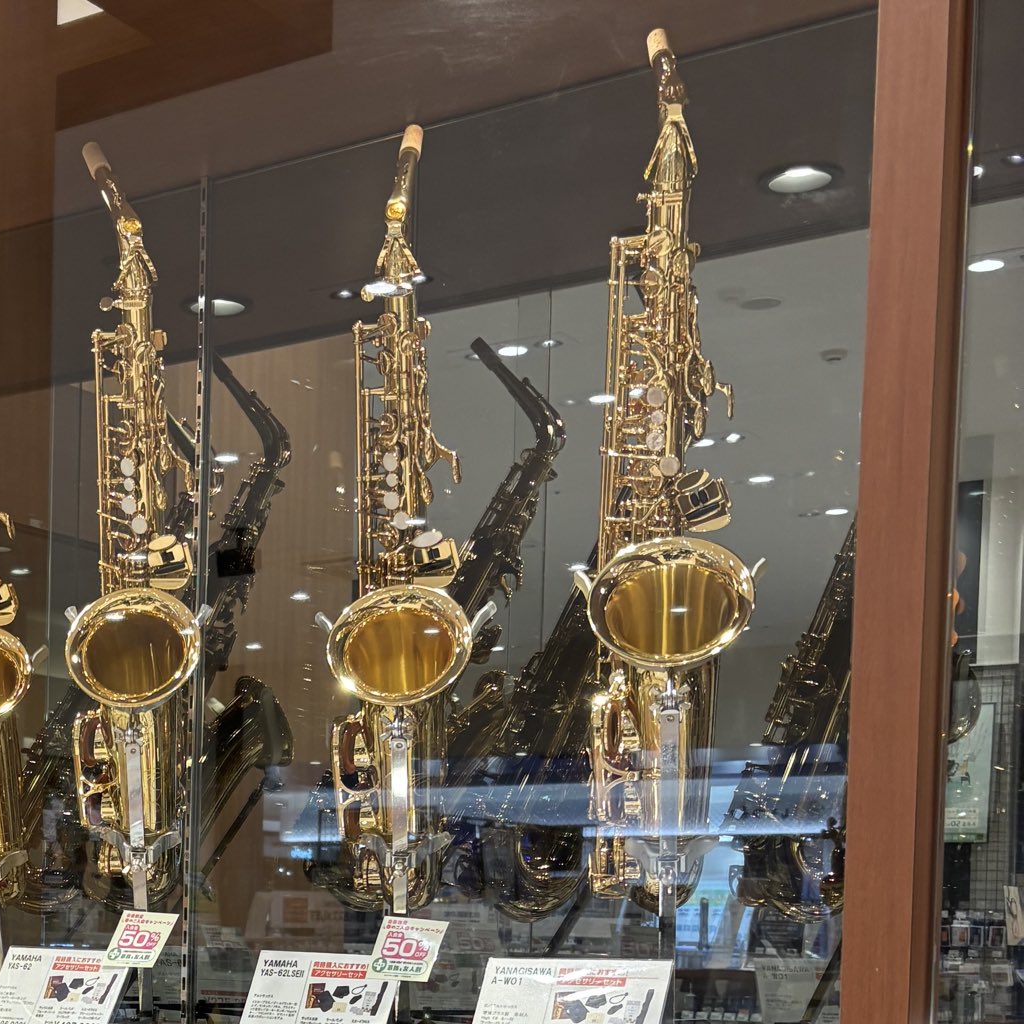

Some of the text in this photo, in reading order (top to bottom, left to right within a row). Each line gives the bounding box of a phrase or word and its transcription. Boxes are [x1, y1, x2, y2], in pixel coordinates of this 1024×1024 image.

[11, 954, 42, 962] YAMAHA
[263, 960, 297, 968] YAMAHA
[315, 970, 364, 978] アクセサリーセット
[495, 966, 552, 976] YANAGISAWA
